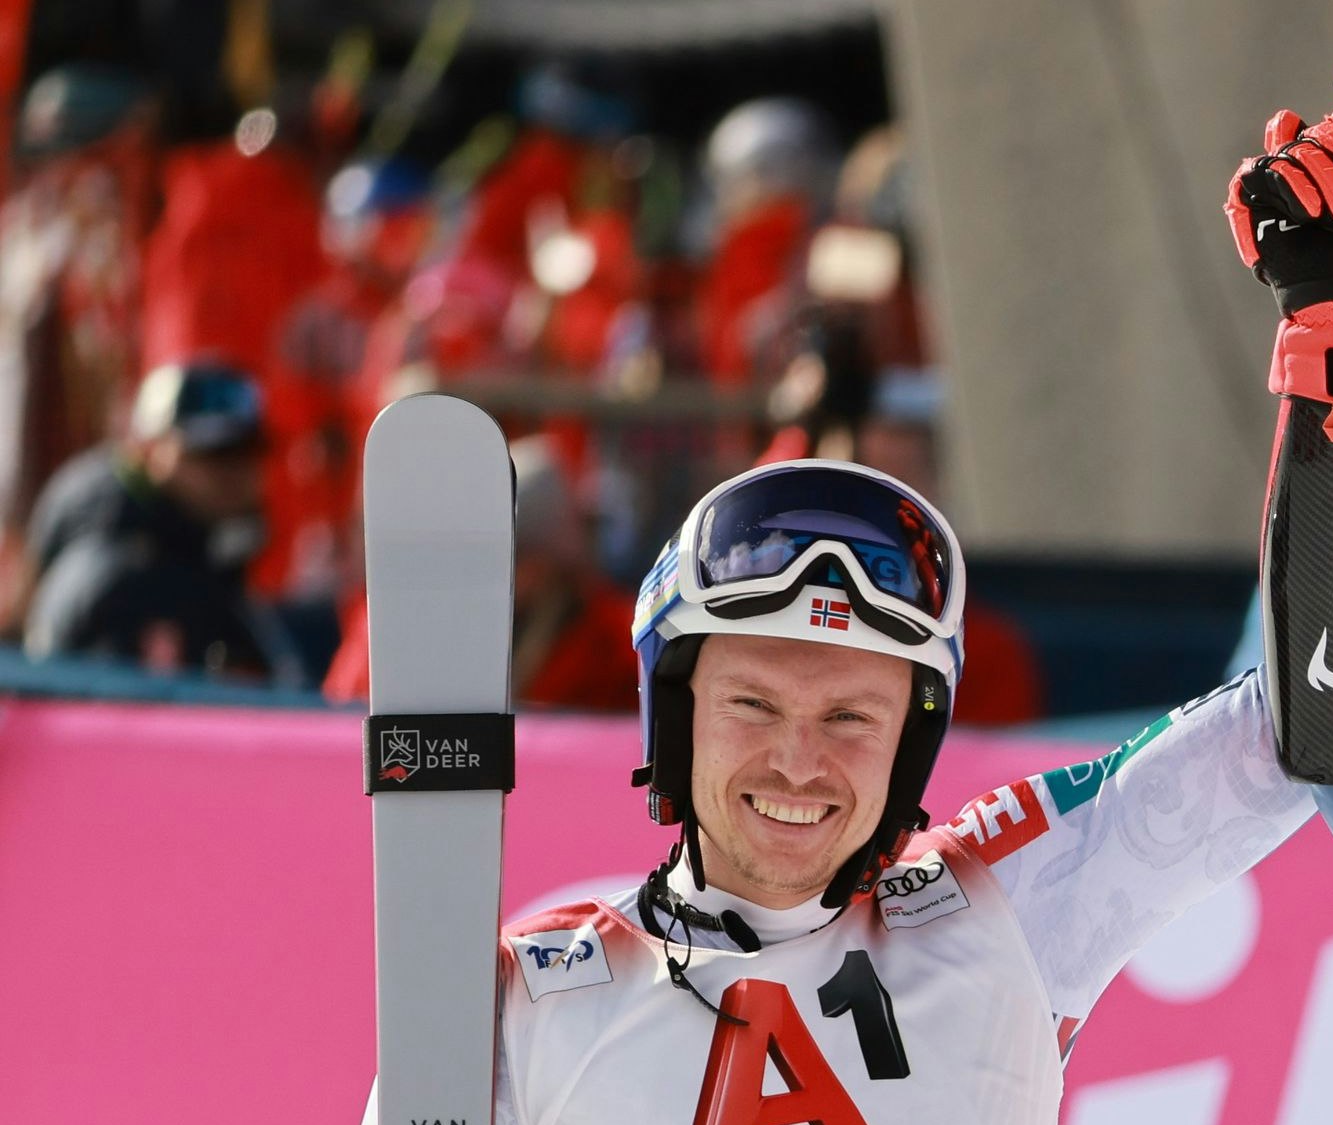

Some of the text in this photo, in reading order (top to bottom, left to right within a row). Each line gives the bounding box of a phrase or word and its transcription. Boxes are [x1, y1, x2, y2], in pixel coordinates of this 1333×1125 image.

[425, 738, 469, 753] VAN
[426, 753, 481, 769] DEER
[914, 899, 940, 914] World
[940, 892, 957, 903] Cup
